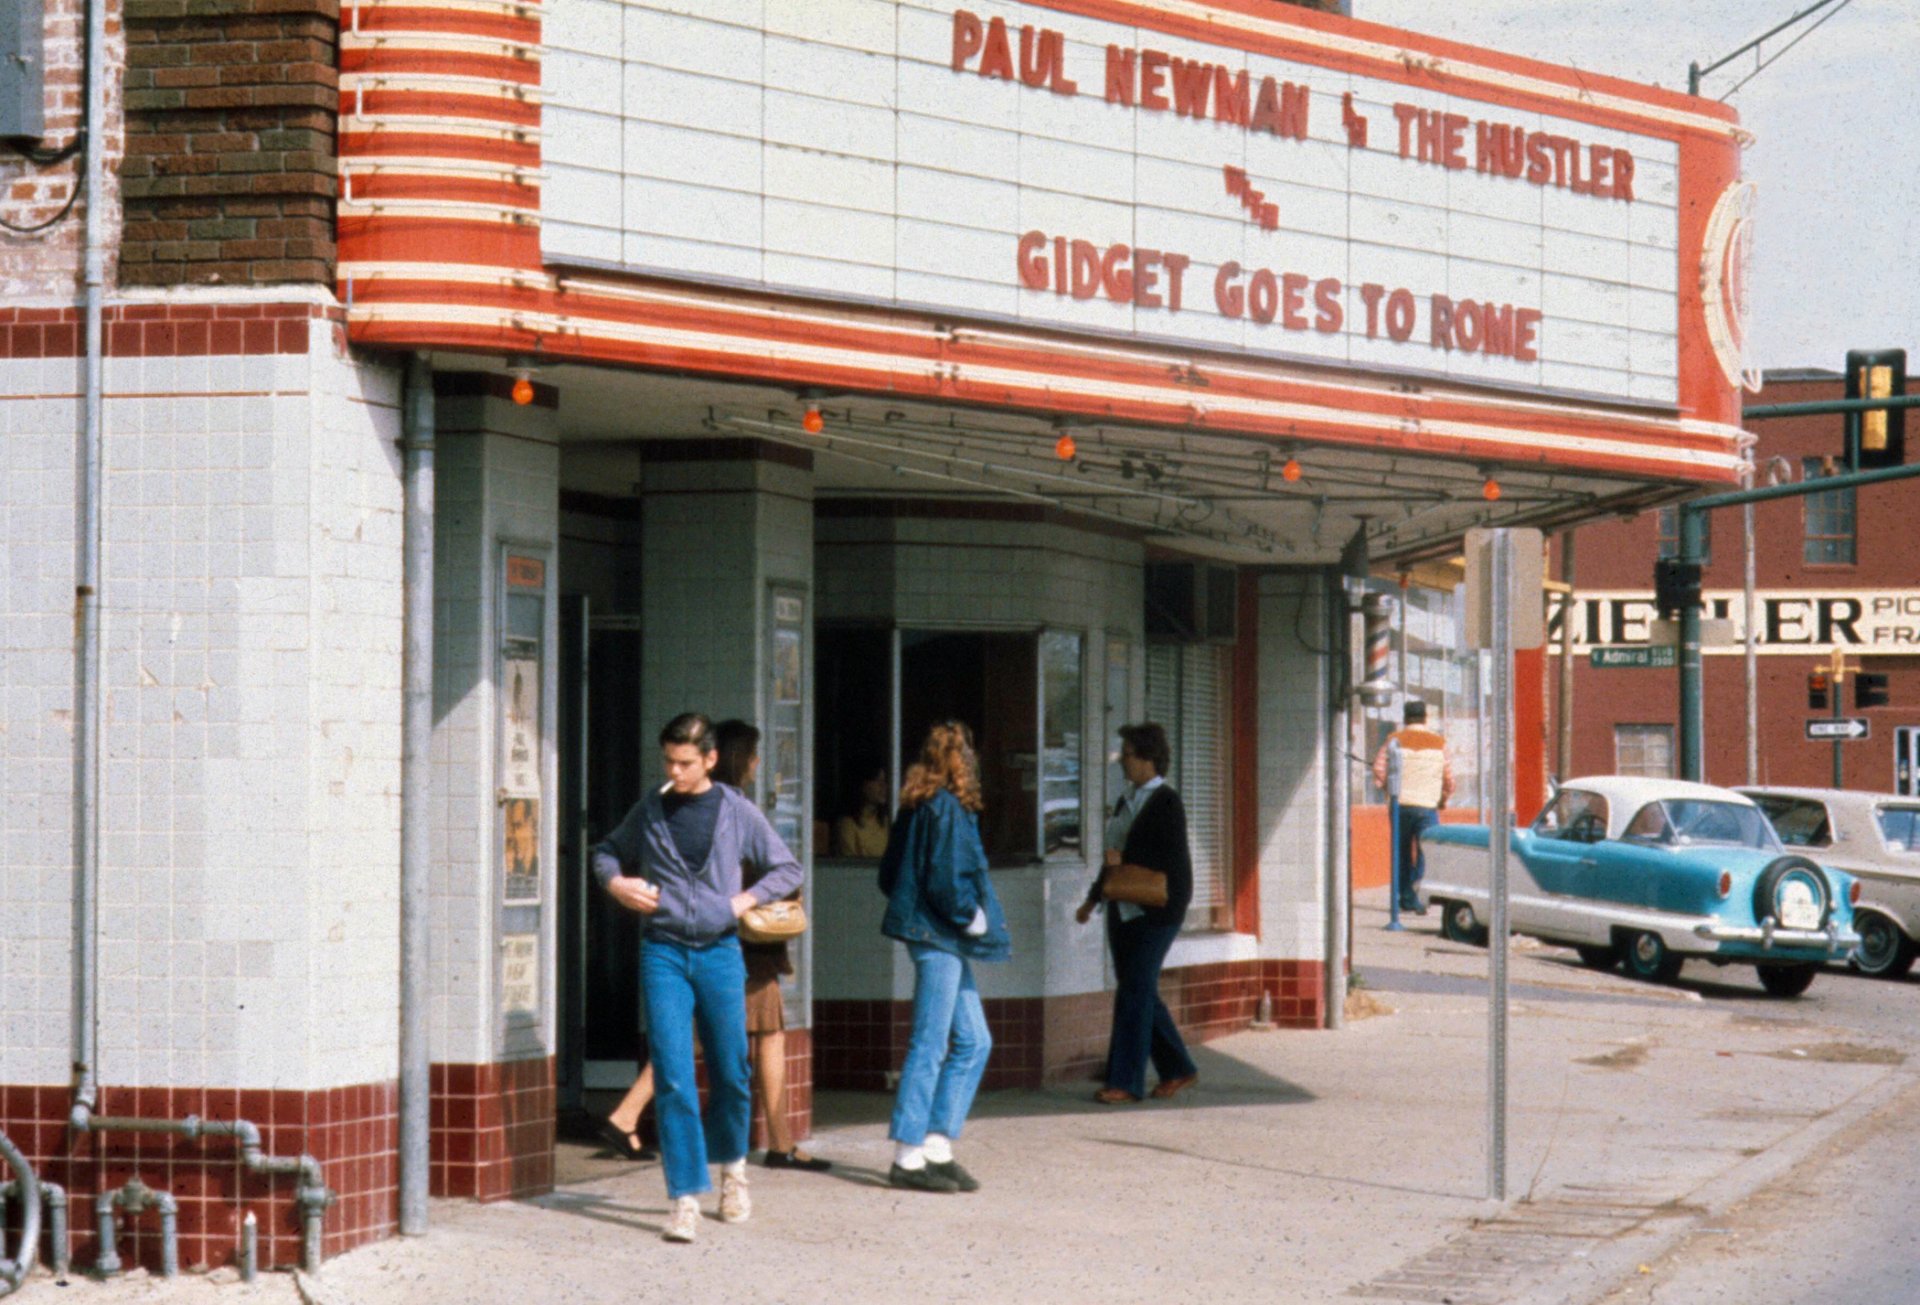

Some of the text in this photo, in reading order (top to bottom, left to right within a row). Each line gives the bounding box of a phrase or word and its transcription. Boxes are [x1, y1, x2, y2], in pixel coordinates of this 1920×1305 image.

[952, 9, 1077, 96] PAUL
[1105, 44, 1310, 141] NEWMAN
[1393, 102, 1469, 170] THE
[1476, 119, 1635, 202] HUSTLER
[1017, 231, 1543, 362] GIDGET GOES TO ROME
[1602, 650, 1648, 664] Admiral
[1872, 625, 1920, 645] FR
